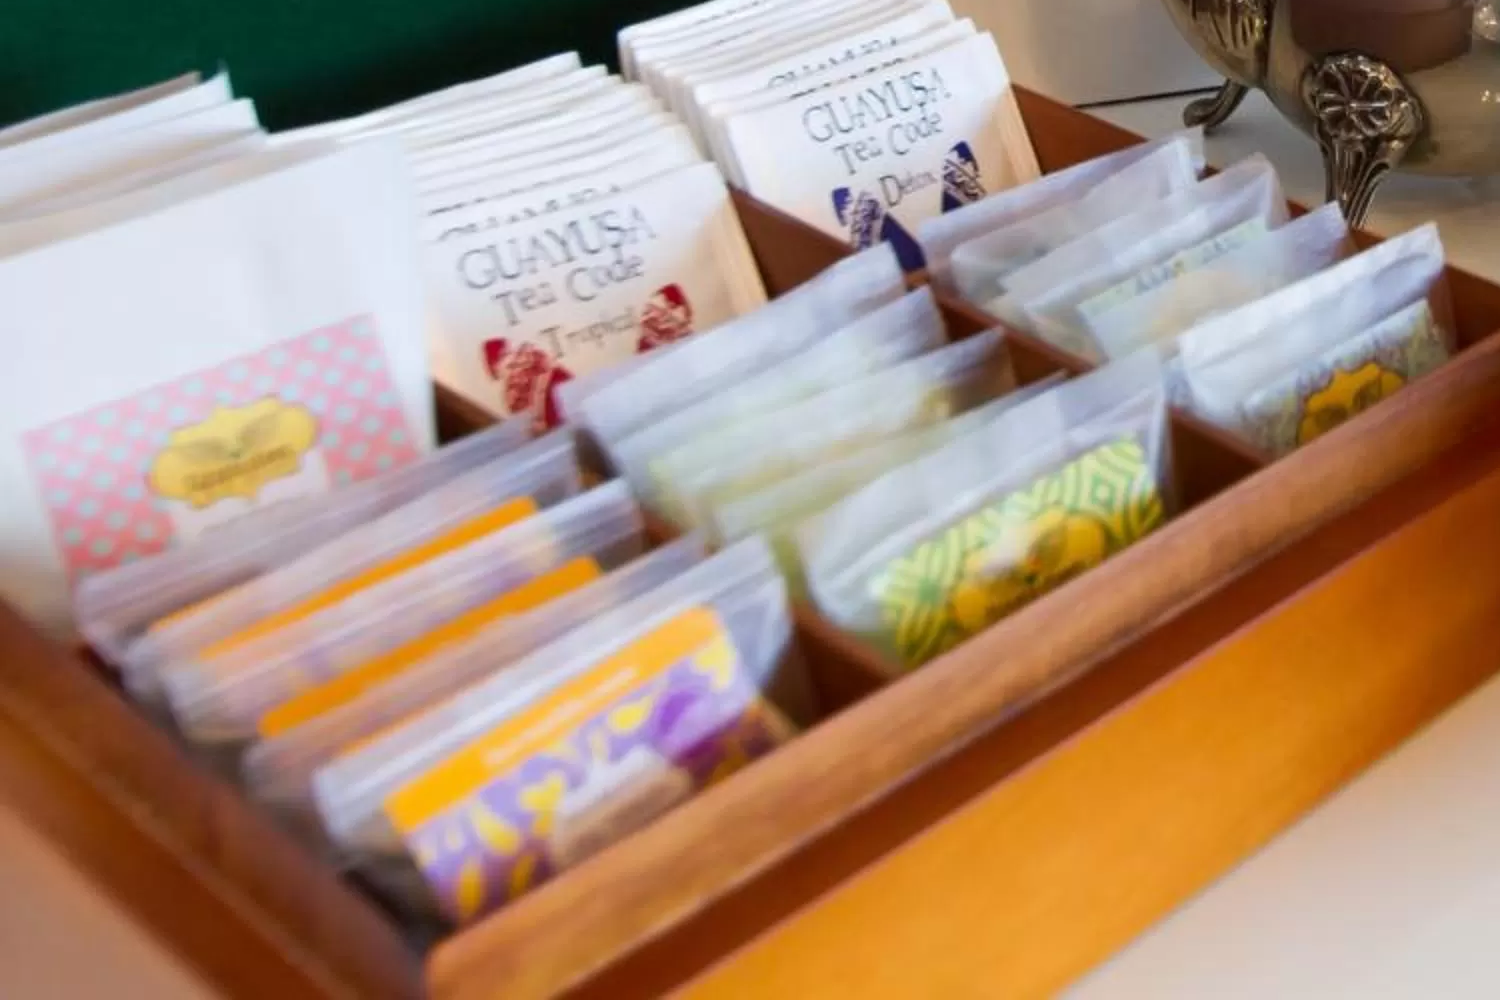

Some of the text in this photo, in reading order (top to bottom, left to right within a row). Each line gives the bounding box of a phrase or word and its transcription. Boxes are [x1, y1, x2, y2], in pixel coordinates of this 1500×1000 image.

[802, 68, 952, 143] GUAYUSA
[887, 101, 943, 156] Code
[456, 204, 658, 290] GUAYUSA
[565, 246, 645, 302] Code
